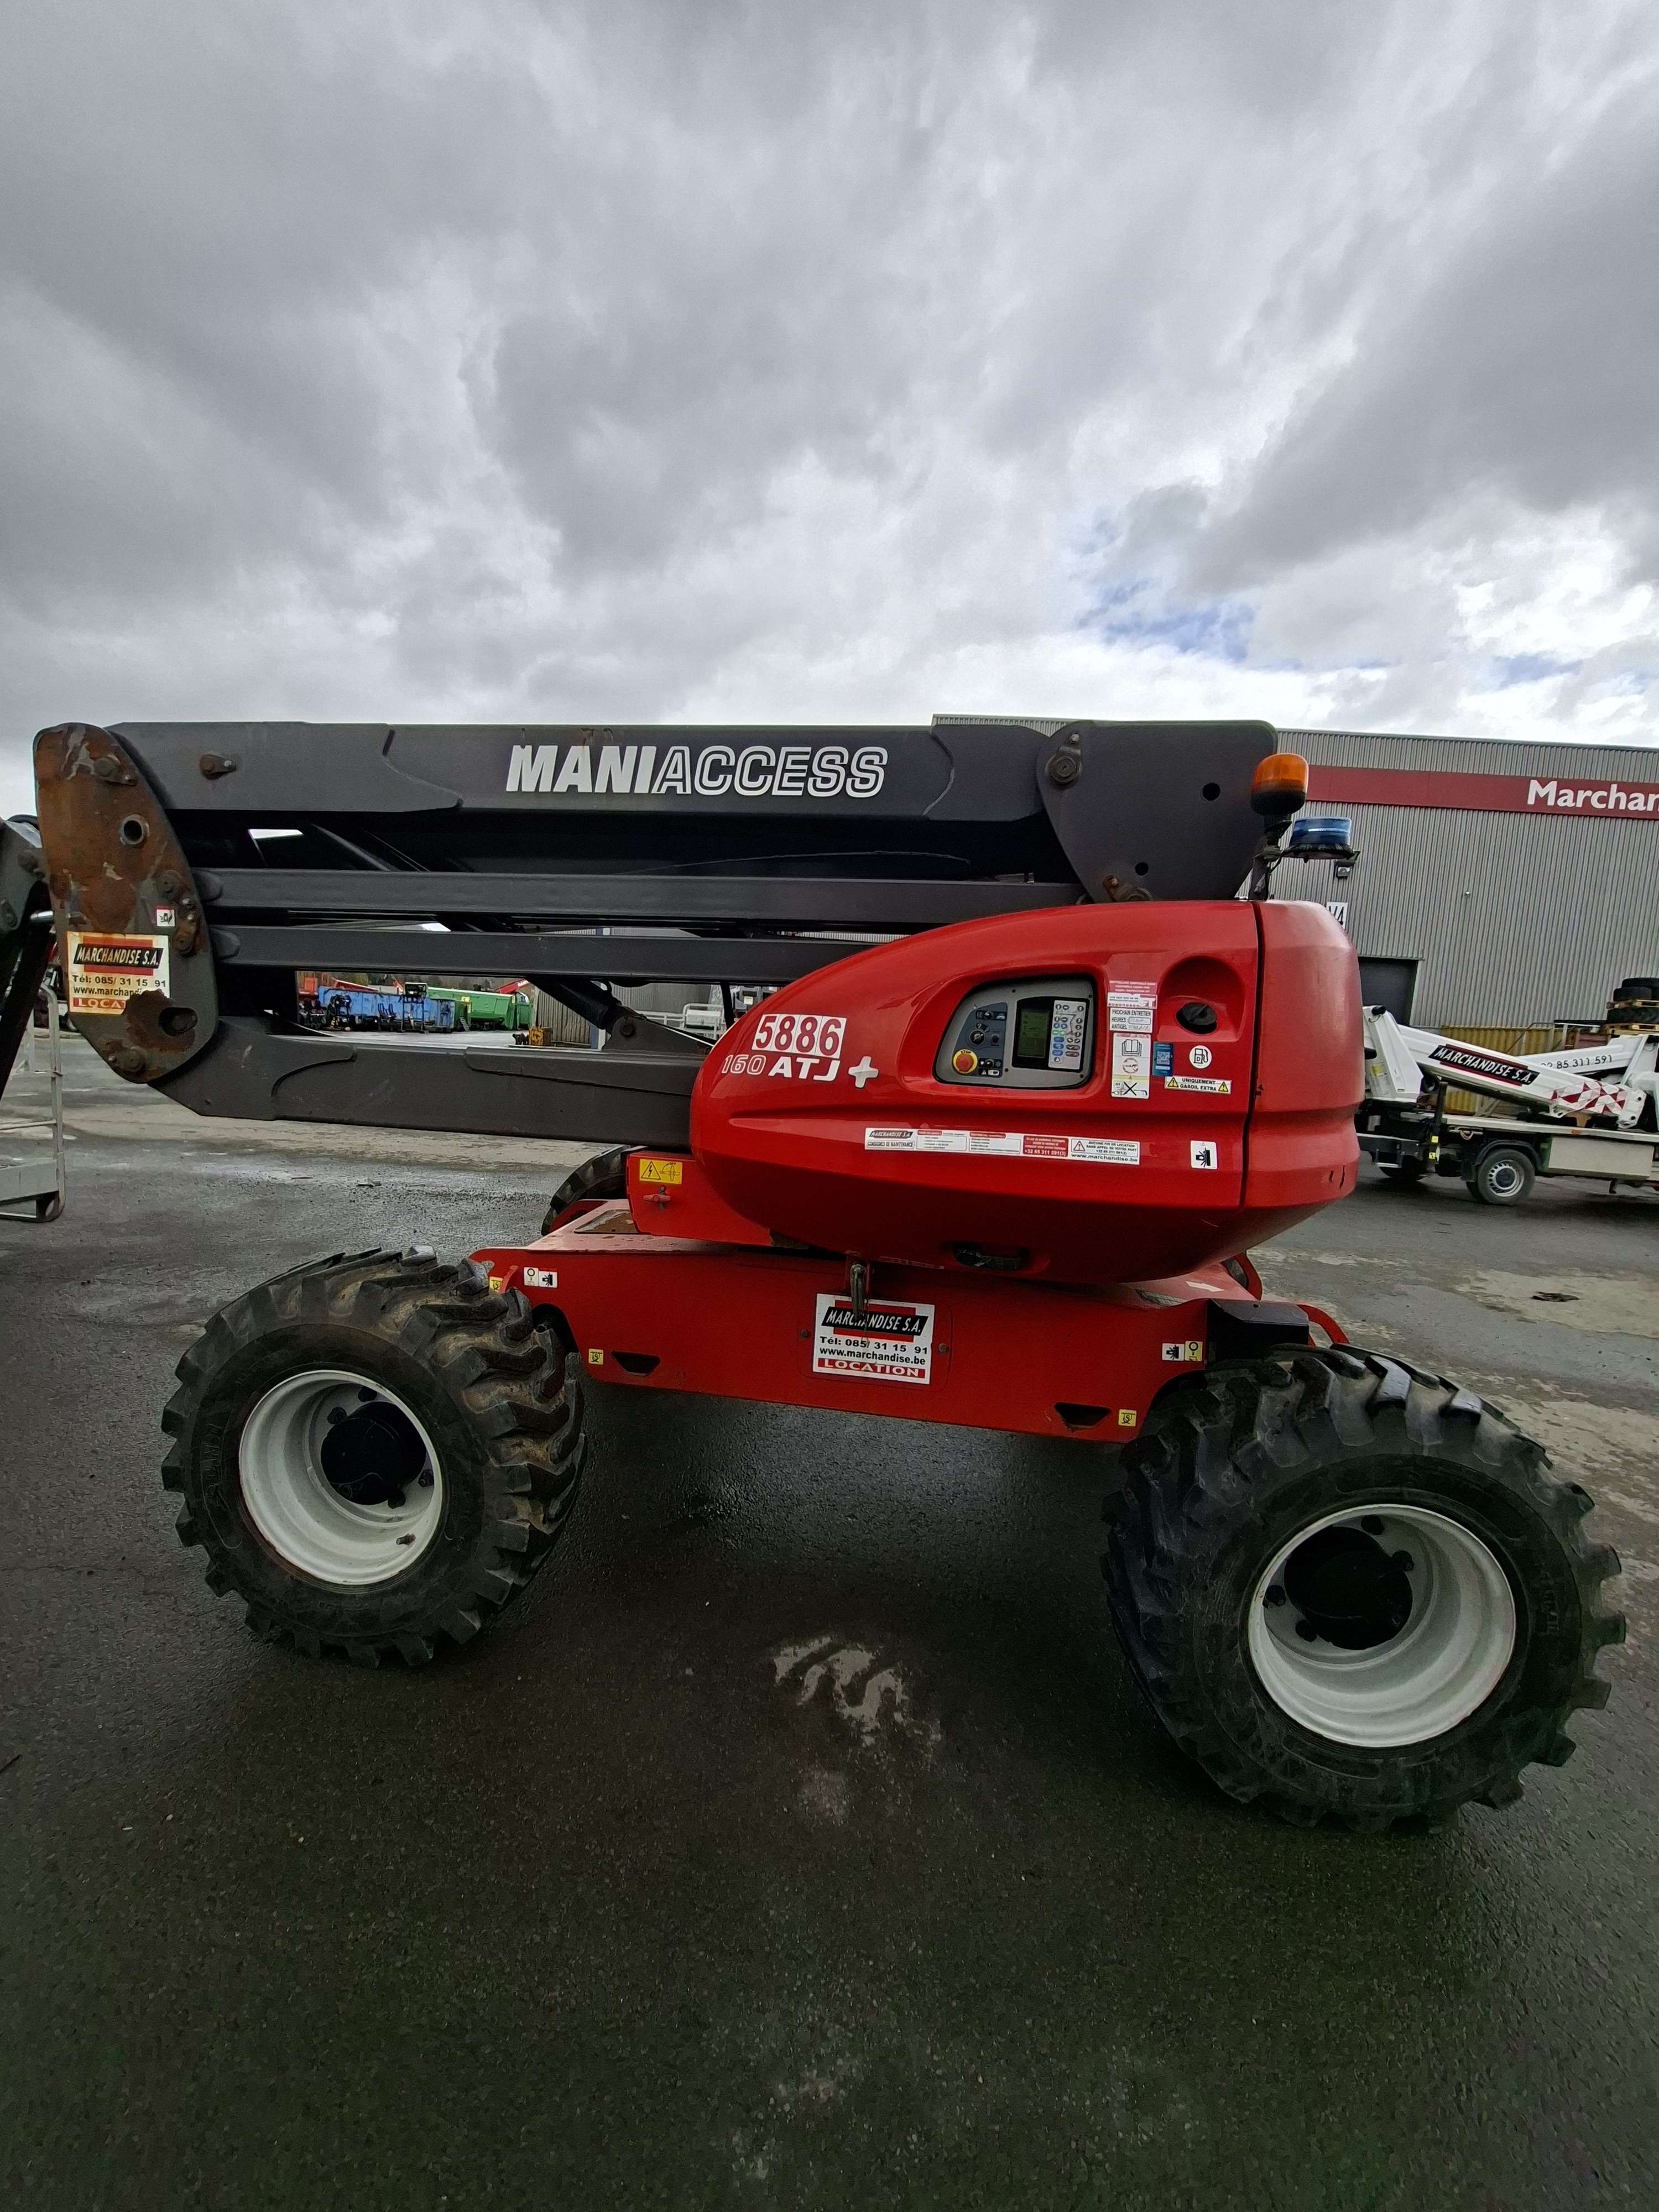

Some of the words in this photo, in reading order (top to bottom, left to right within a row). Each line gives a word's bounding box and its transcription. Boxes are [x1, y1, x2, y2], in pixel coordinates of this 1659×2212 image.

[506, 745, 888, 798] MANIACCESS
[77, 946, 141, 964] MARCHANDISE
[142, 951, 159, 965] S.A.
[95, 976, 116, 985] 085/
[79, 998, 126, 1008] LOCA
[756, 1016, 842, 1056] 5886
[721, 1054, 766, 1075] 160
[768, 1056, 841, 1081] ATJ
[1434, 1048, 1514, 1077] MARCHANDISE
[1512, 1070, 1532, 1083] S.A.
[1557, 1060, 1569, 1069] 85
[1573, 1057, 1590, 1067] 311
[1595, 1055, 1613, 1065] 591
[902, 1316, 921, 1333] S.A.
[820, 1336, 842, 1345] Tél:
[845, 1339, 870, 1348] 085/
[874, 1342, 887, 1350] 31
[893, 1344, 907, 1352] 15
[914, 1346, 928, 1354] 91
[820, 1347, 926, 1365] www.marchandise.be
[824, 1359, 919, 1377] LOCATION
